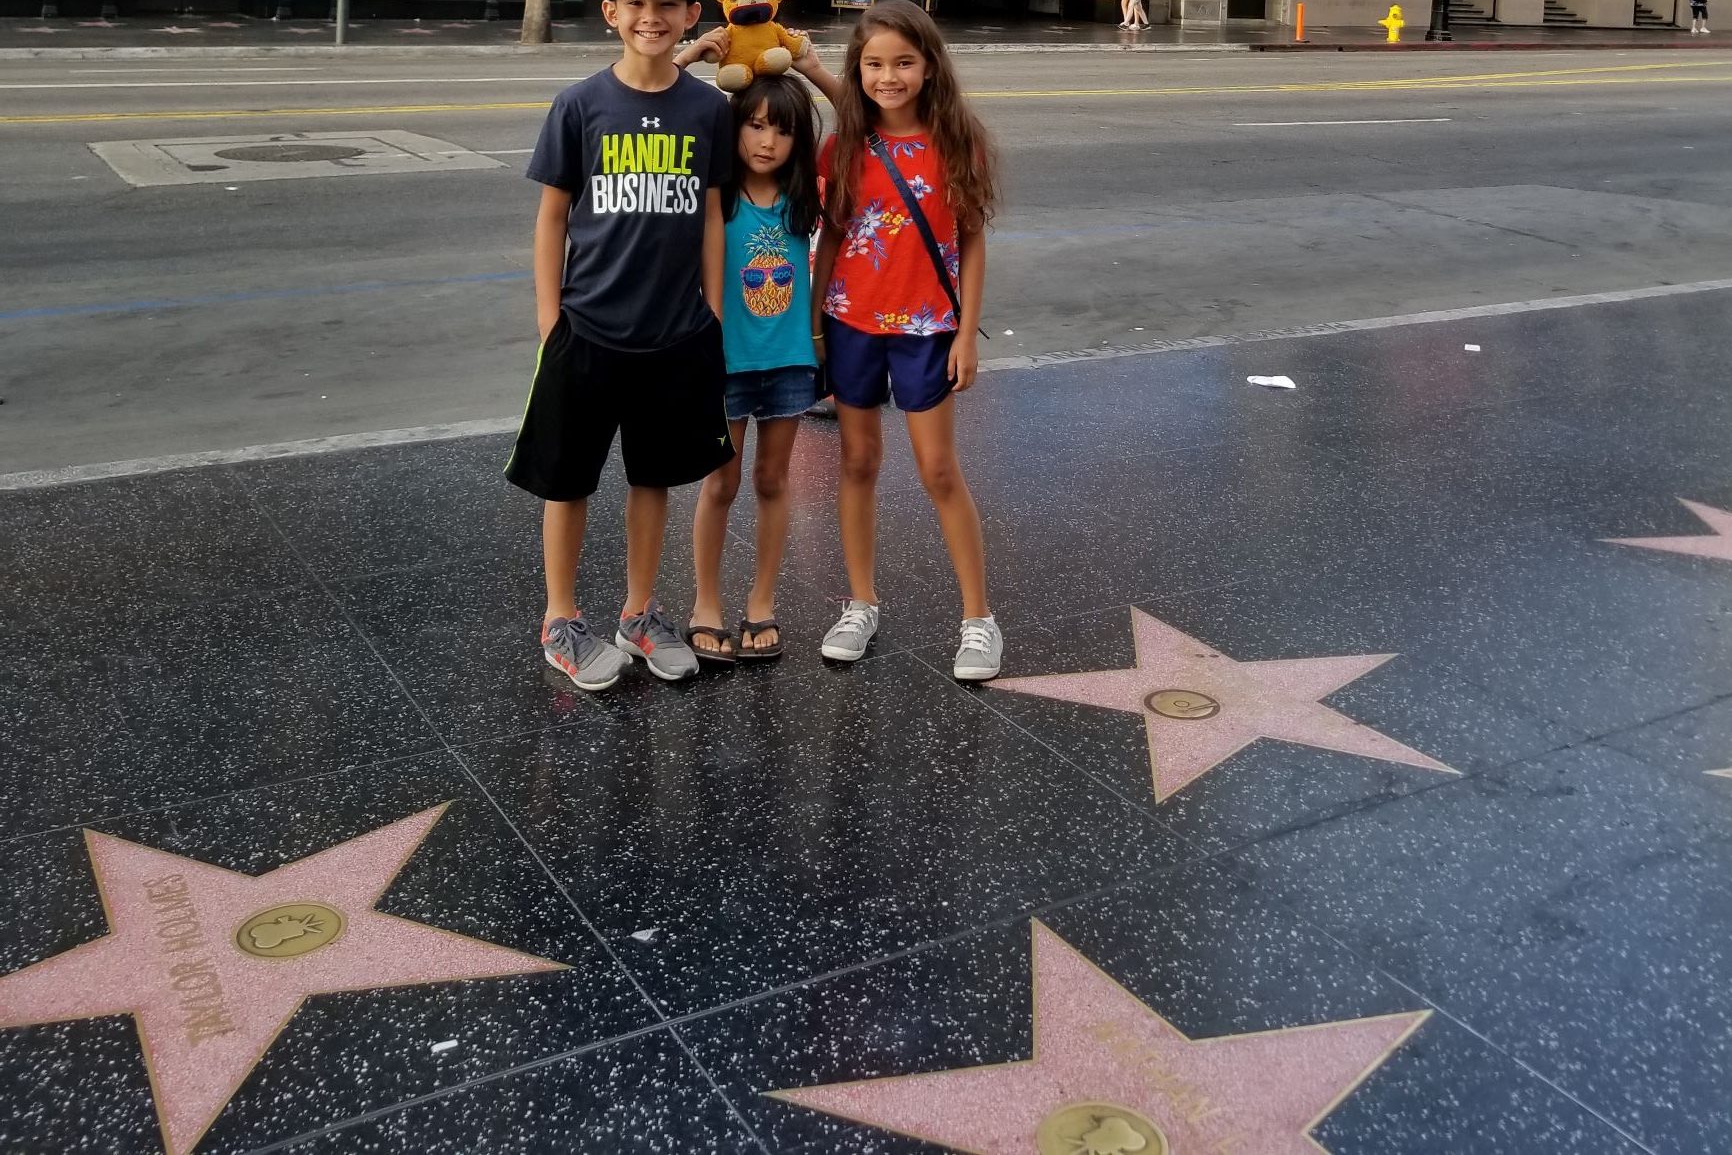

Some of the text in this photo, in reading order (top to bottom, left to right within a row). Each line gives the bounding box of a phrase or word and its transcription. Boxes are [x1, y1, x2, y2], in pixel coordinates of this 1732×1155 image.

[602, 133, 696, 174] HANDLE
[591, 173, 700, 214] BUSINESS
[143, 873, 206, 955] HOLMES
